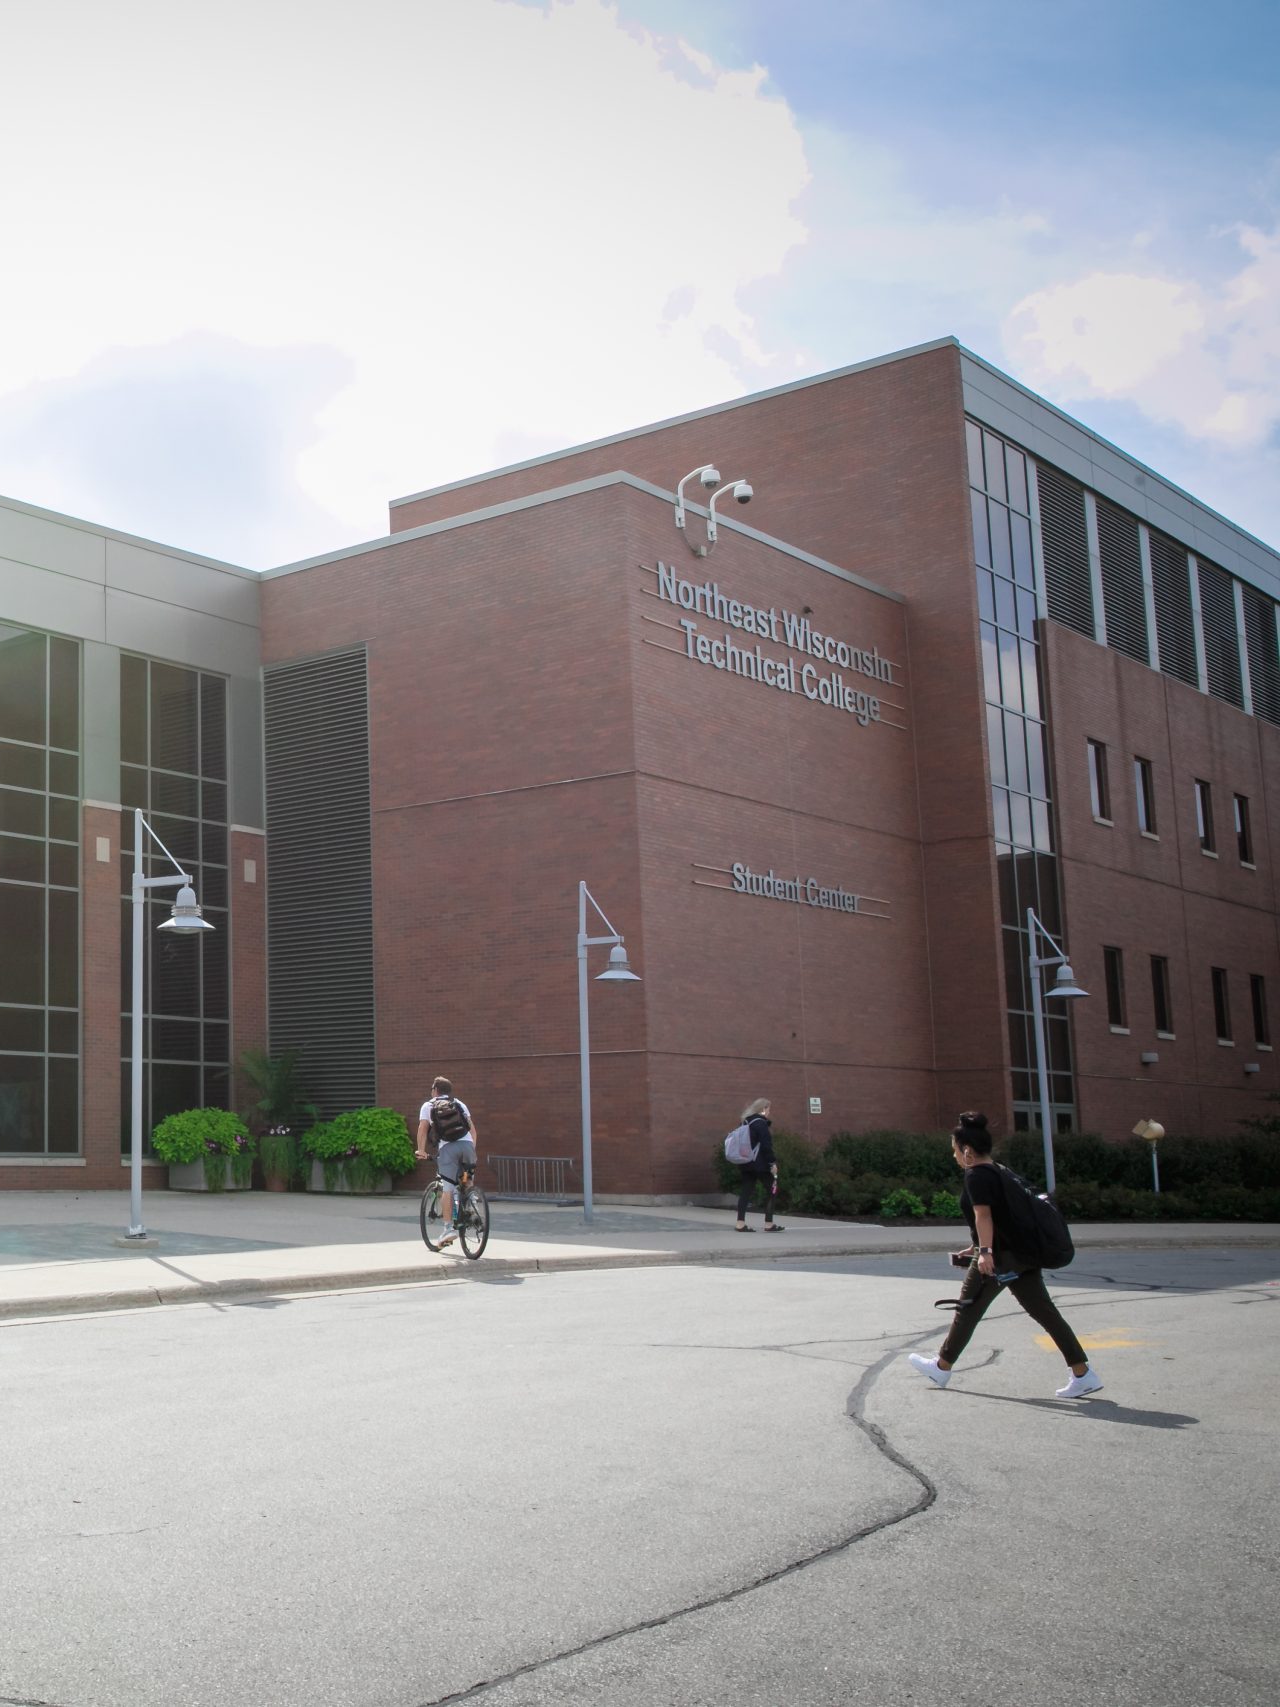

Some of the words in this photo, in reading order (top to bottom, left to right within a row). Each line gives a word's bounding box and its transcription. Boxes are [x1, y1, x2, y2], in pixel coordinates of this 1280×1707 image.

[658, 561, 778, 642] Northeast
[782, 609, 893, 683] Wisconsin
[680, 619, 796, 692] Technical
[802, 663, 880, 727] College
[732, 863, 803, 904] Student
[806, 877, 860, 913] Center
